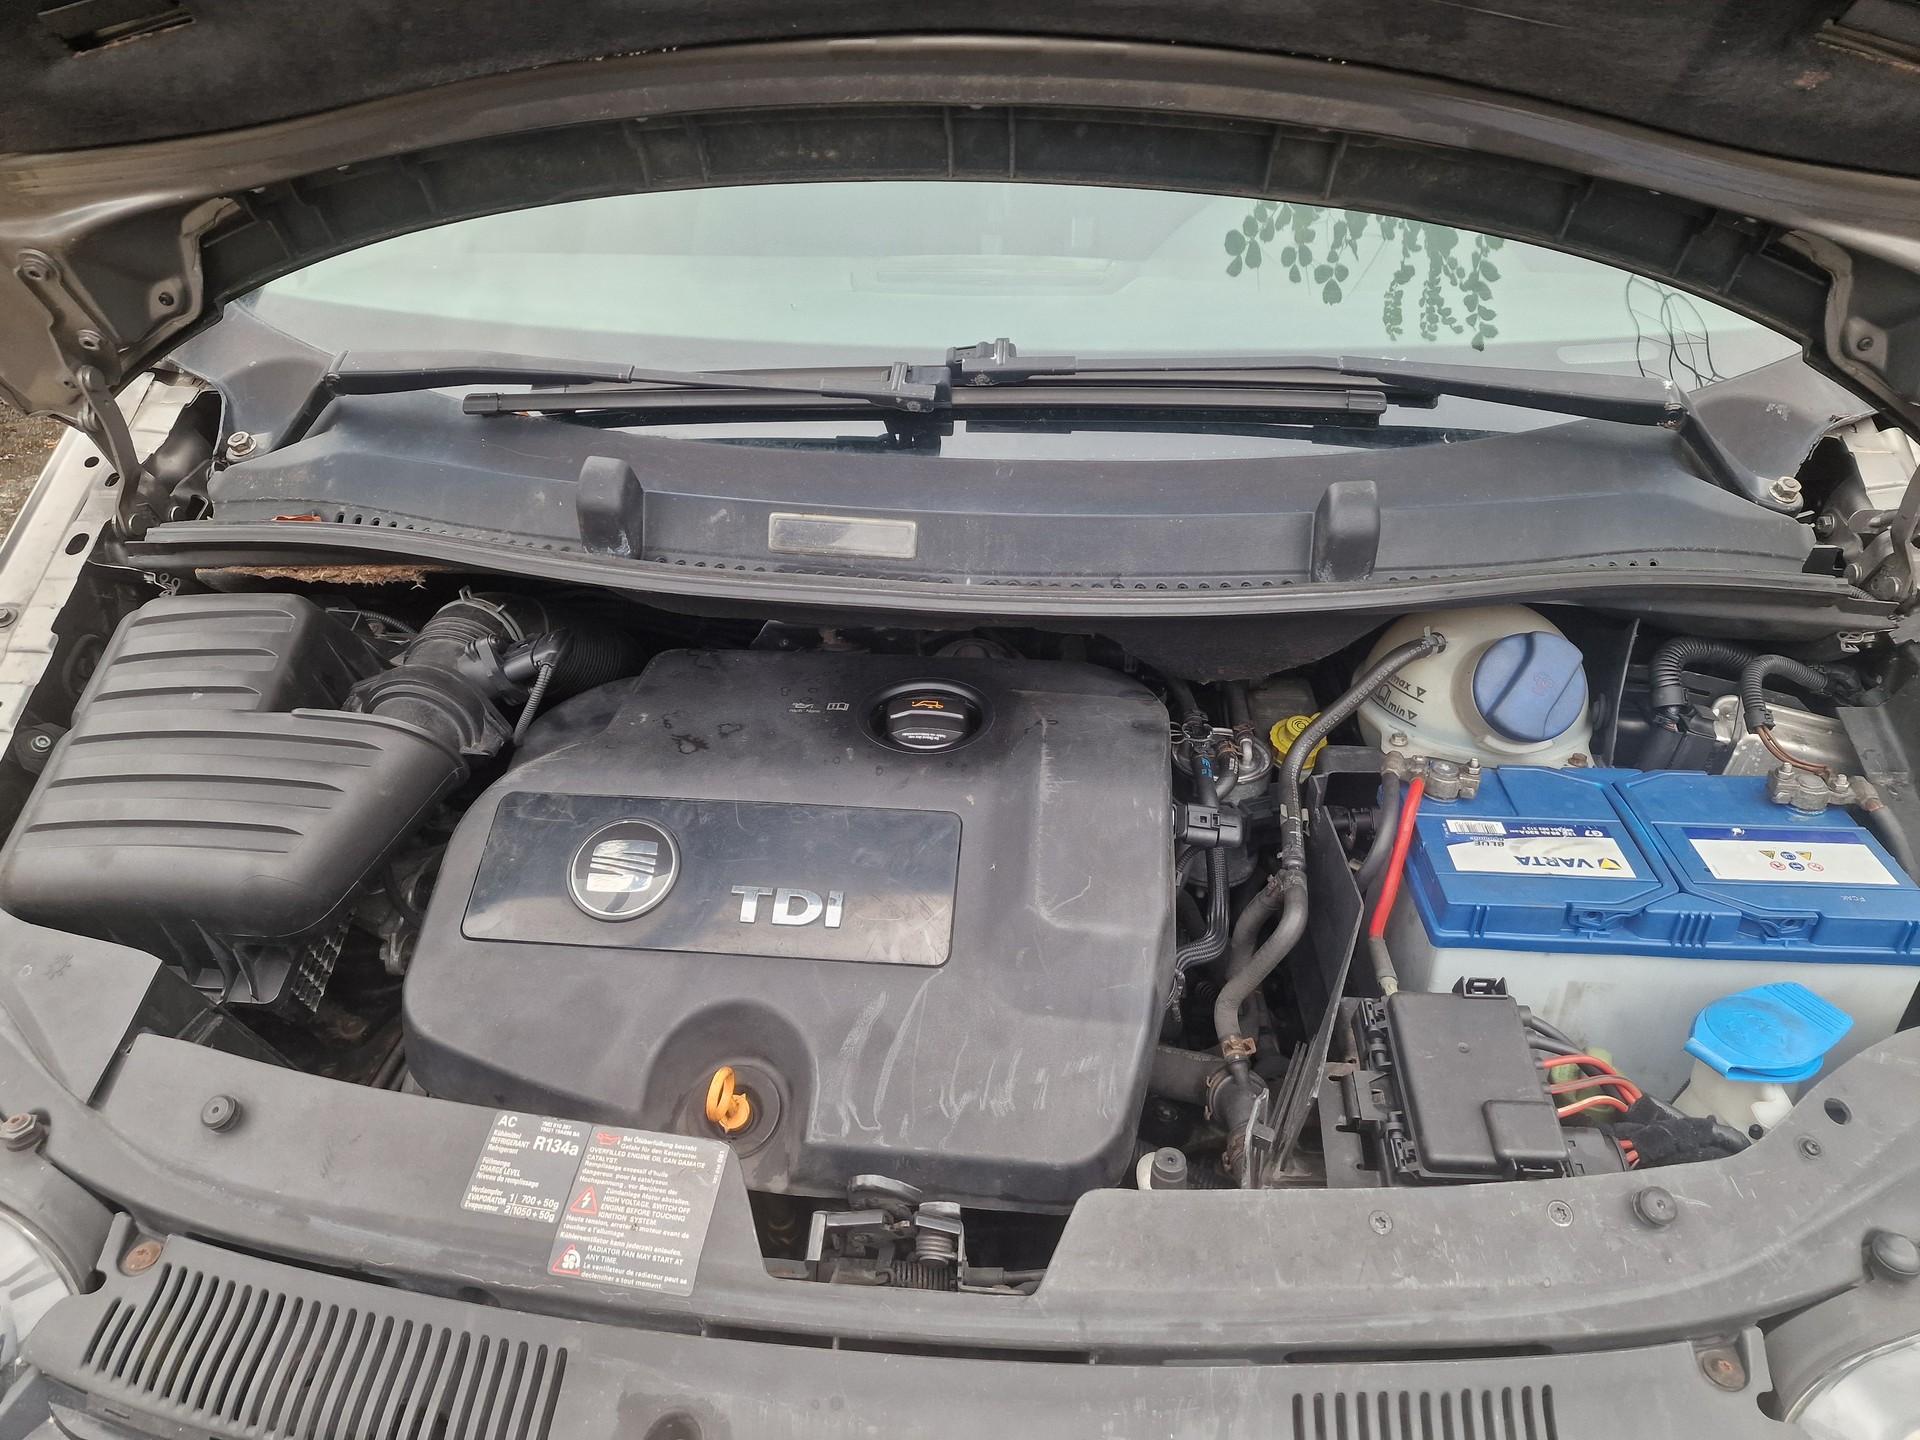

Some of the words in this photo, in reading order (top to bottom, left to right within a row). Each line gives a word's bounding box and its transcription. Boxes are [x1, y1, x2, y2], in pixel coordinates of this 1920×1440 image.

[1390, 675, 1411, 690] max
[1388, 701, 1405, 716] min
[1585, 829, 1603, 837] G7
[1514, 855, 1594, 868] VARTA
[731, 885, 845, 928] TDI
[498, 1114, 519, 1127] AC
[493, 1129, 522, 1139] Kühlmittel
[487, 1144, 518, 1154] Refrigerant
[490, 1136, 530, 1148] REFRIGERANT
[533, 1136, 579, 1156] R134a
[634, 1137, 673, 1149] Ölüberfüllung
[674, 1143, 697, 1151] besteht
[586, 1154, 618, 1163] CATALYST.
[589, 1147, 626, 1157] OVERFILLED
[627, 1152, 650, 1160] ENGINE
[678, 1159, 705, 1168] DAMAGE
[621, 1143, 640, 1151] Gefahr
[664, 1149, 697, 1159] Katalysator.
[481, 1157, 511, 1168] Füllmenge
[583, 1160, 622, 1171] Remplissage
[648, 1170, 668, 1178] d'huile
[479, 1164, 505, 1174] CHARGE
[503, 1168, 520, 1177] LEVEL
[580, 1168, 613, 1177] dangereux
[638, 1177, 668, 1185] catalyseur.
[476, 1172, 496, 1181] Niveau
[504, 1177, 539, 1188] remplissage
[578, 1175, 623, 1188] Hochspannung
[639, 1184, 666, 1194] Berühren
[471, 1185, 503, 1196] Verdampfer
[606, 1188, 641, 1199] Zündanlage
[642, 1193, 660, 1201] Motor
[662, 1197, 689, 1205] abstellen.
[464, 1200, 499, 1212] Evaporateur
[467, 1193, 506, 1205] EVAPORATOR
[510, 1193, 514, 1202] 1
[521, 1195, 536, 1205] 700
[543, 1199, 559, 1210] 50g
[504, 1205, 511, 1214] 2
[513, 1206, 532, 1217] 1050
[539, 1211, 555, 1223] 50g
[601, 1204, 625, 1212] ENGINE
[626, 1207, 650, 1217] BEFORE
[652, 1211, 685, 1222] TOUCHING
[652, 1203, 677, 1212] SWITCH
[598, 1211, 627, 1221] IGNITION
[629, 1216, 656, 1225] SYSTEM.
[563, 1223, 587, 1231] toucher
[565, 1214, 584, 1222] Haute
[638, 1226, 662, 1234] moteur
[663, 1230, 680, 1238] avant
[559, 1231, 609, 1244] Kühlerventilator
[625, 1242, 653, 1252] jederzeit
[654, 1247, 681, 1256] anlaufen.
[587, 1245, 620, 1256] RADIATOR
[622, 1250, 635, 1258] FAN
[636, 1252, 651, 1260] MAY
[652, 1255, 673, 1264] START
[601, 1256, 617, 1264] TIME.
[592, 1265, 625, 1274] ventilateur
[635, 1272, 663, 1280] radiateur
